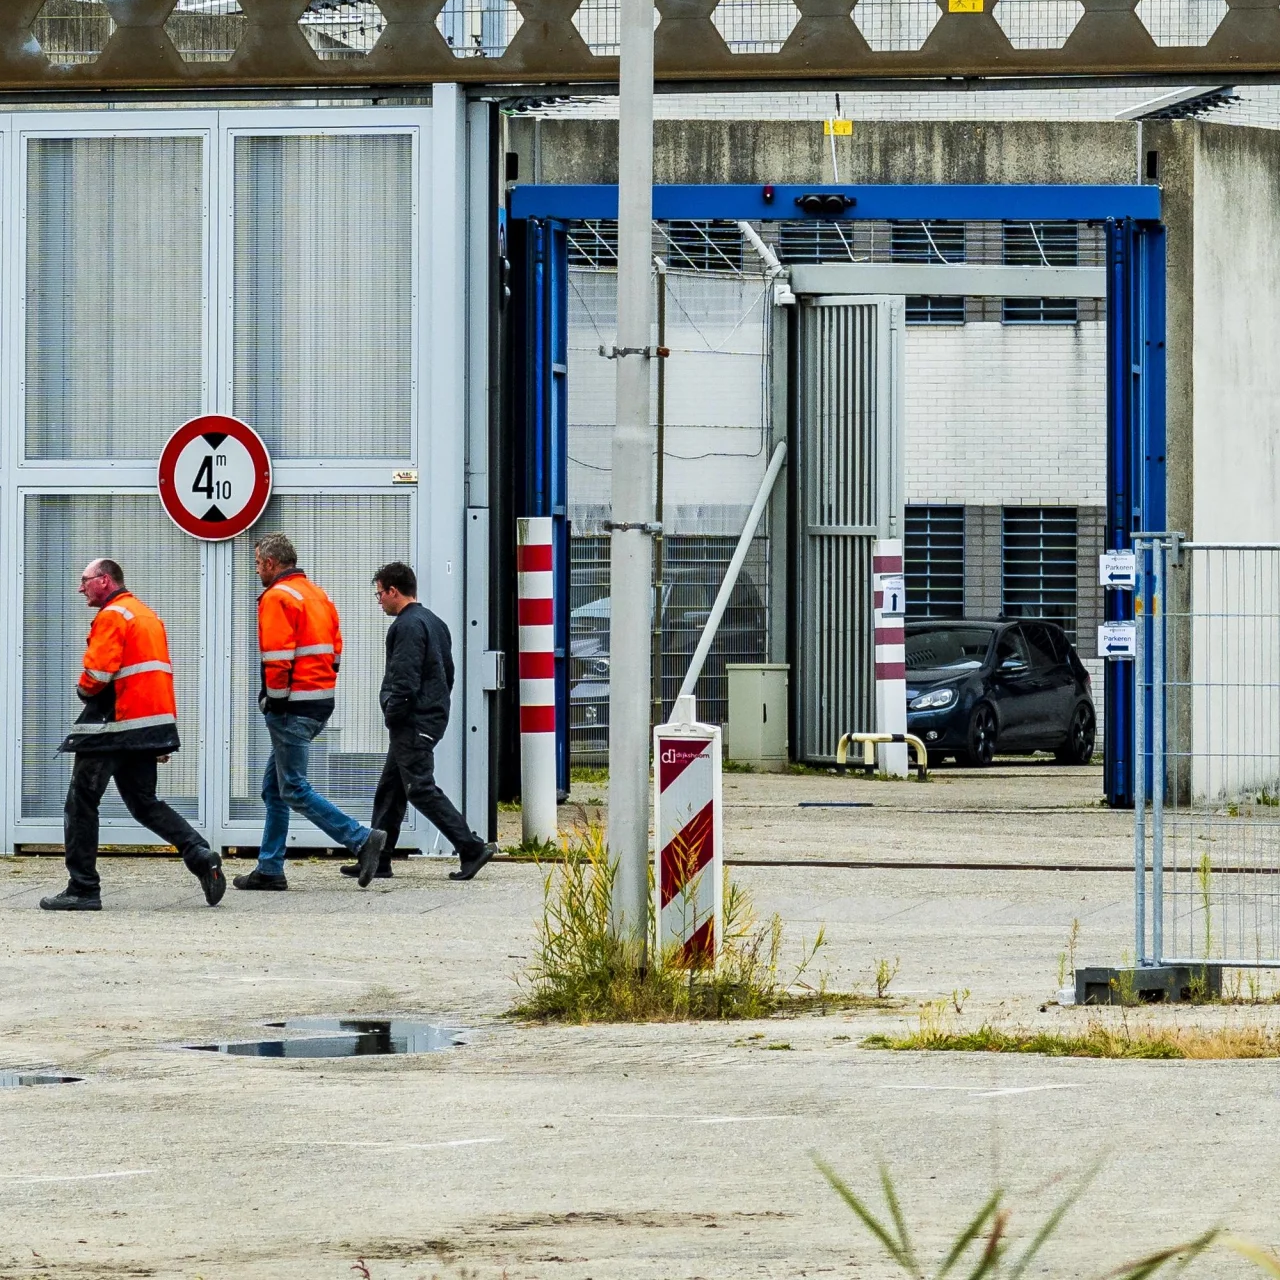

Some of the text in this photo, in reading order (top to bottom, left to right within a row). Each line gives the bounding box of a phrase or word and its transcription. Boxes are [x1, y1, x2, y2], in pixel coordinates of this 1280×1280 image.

[192, 454, 232, 500] 4 m 10
